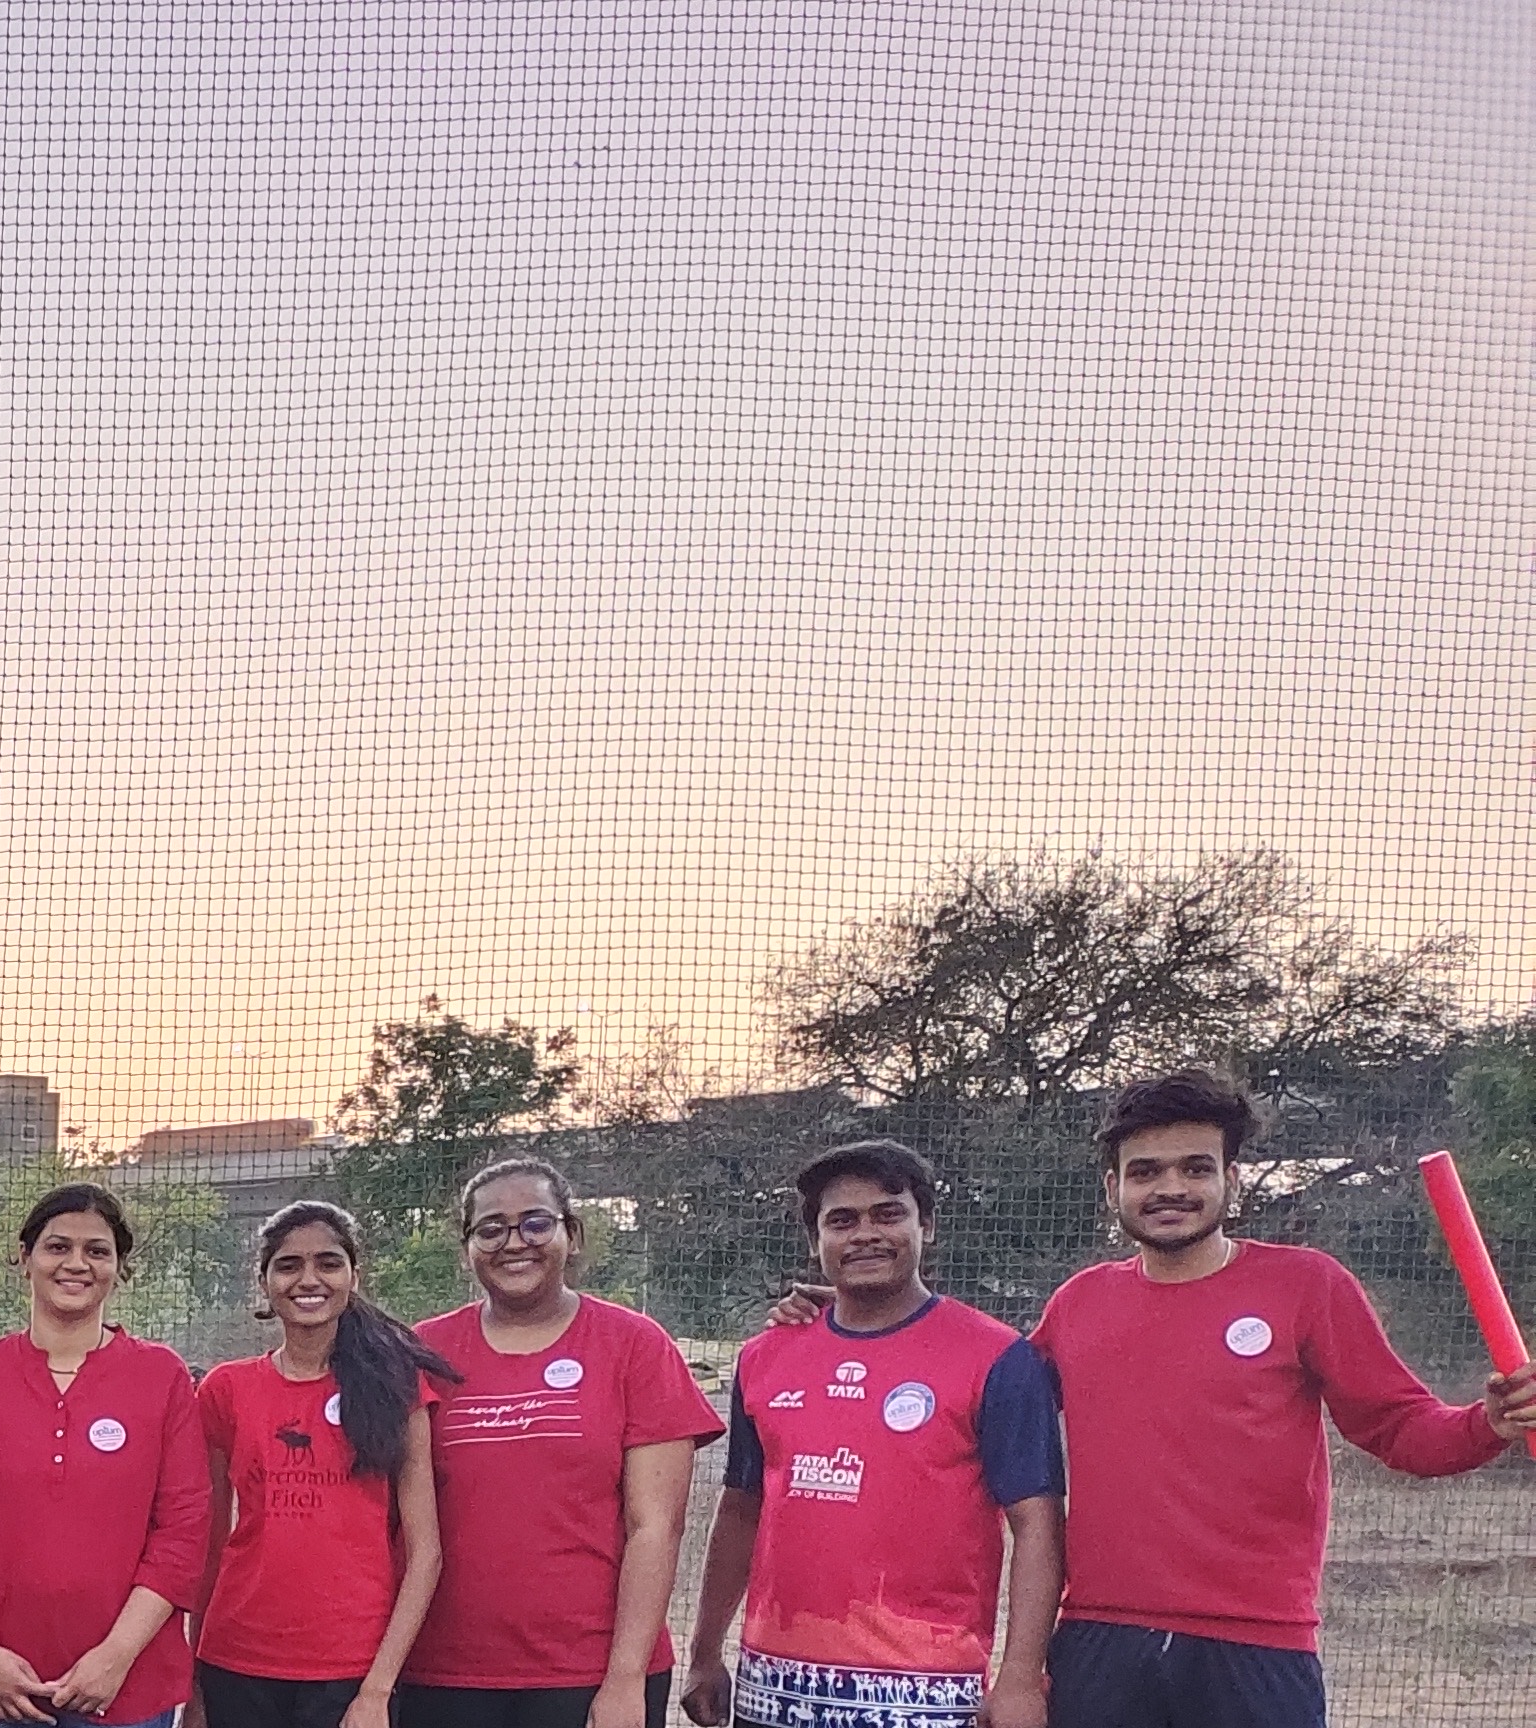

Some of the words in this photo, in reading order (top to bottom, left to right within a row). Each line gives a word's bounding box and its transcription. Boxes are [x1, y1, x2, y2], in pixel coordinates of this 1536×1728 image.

[827, 1385, 866, 1400] TATA
[522, 1399, 544, 1411] the
[792, 1454, 829, 1468] TATA
[790, 1465, 862, 1487] TISCON
